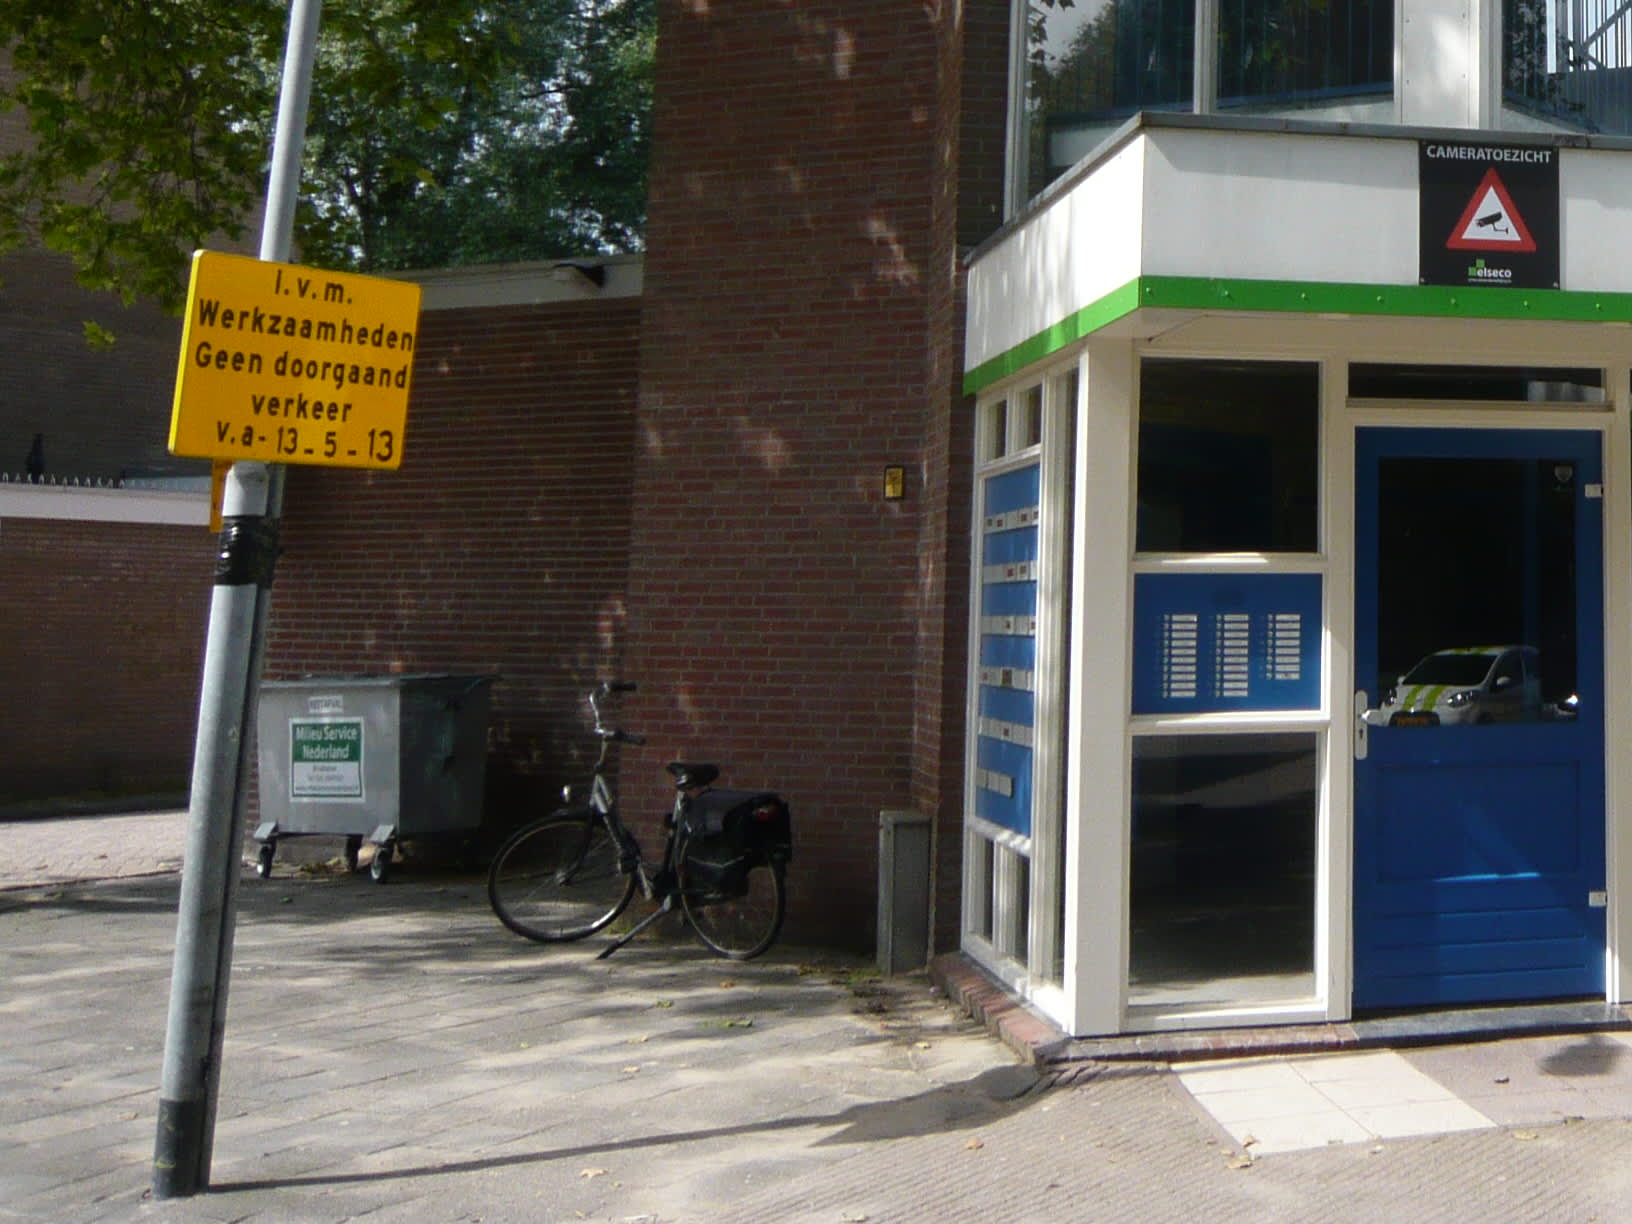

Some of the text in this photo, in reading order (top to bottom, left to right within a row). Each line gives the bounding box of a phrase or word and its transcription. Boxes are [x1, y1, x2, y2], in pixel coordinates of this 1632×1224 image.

[1426, 145, 1551, 163] CAMERATOEZICHT
[199, 298, 412, 351] Werkzaamheden
[195, 341, 409, 390] Geen doorgaand
[252, 393, 352, 423] verkeer
[296, 725, 357, 740] Milieu Service
[303, 743, 349, 759] Nederland
